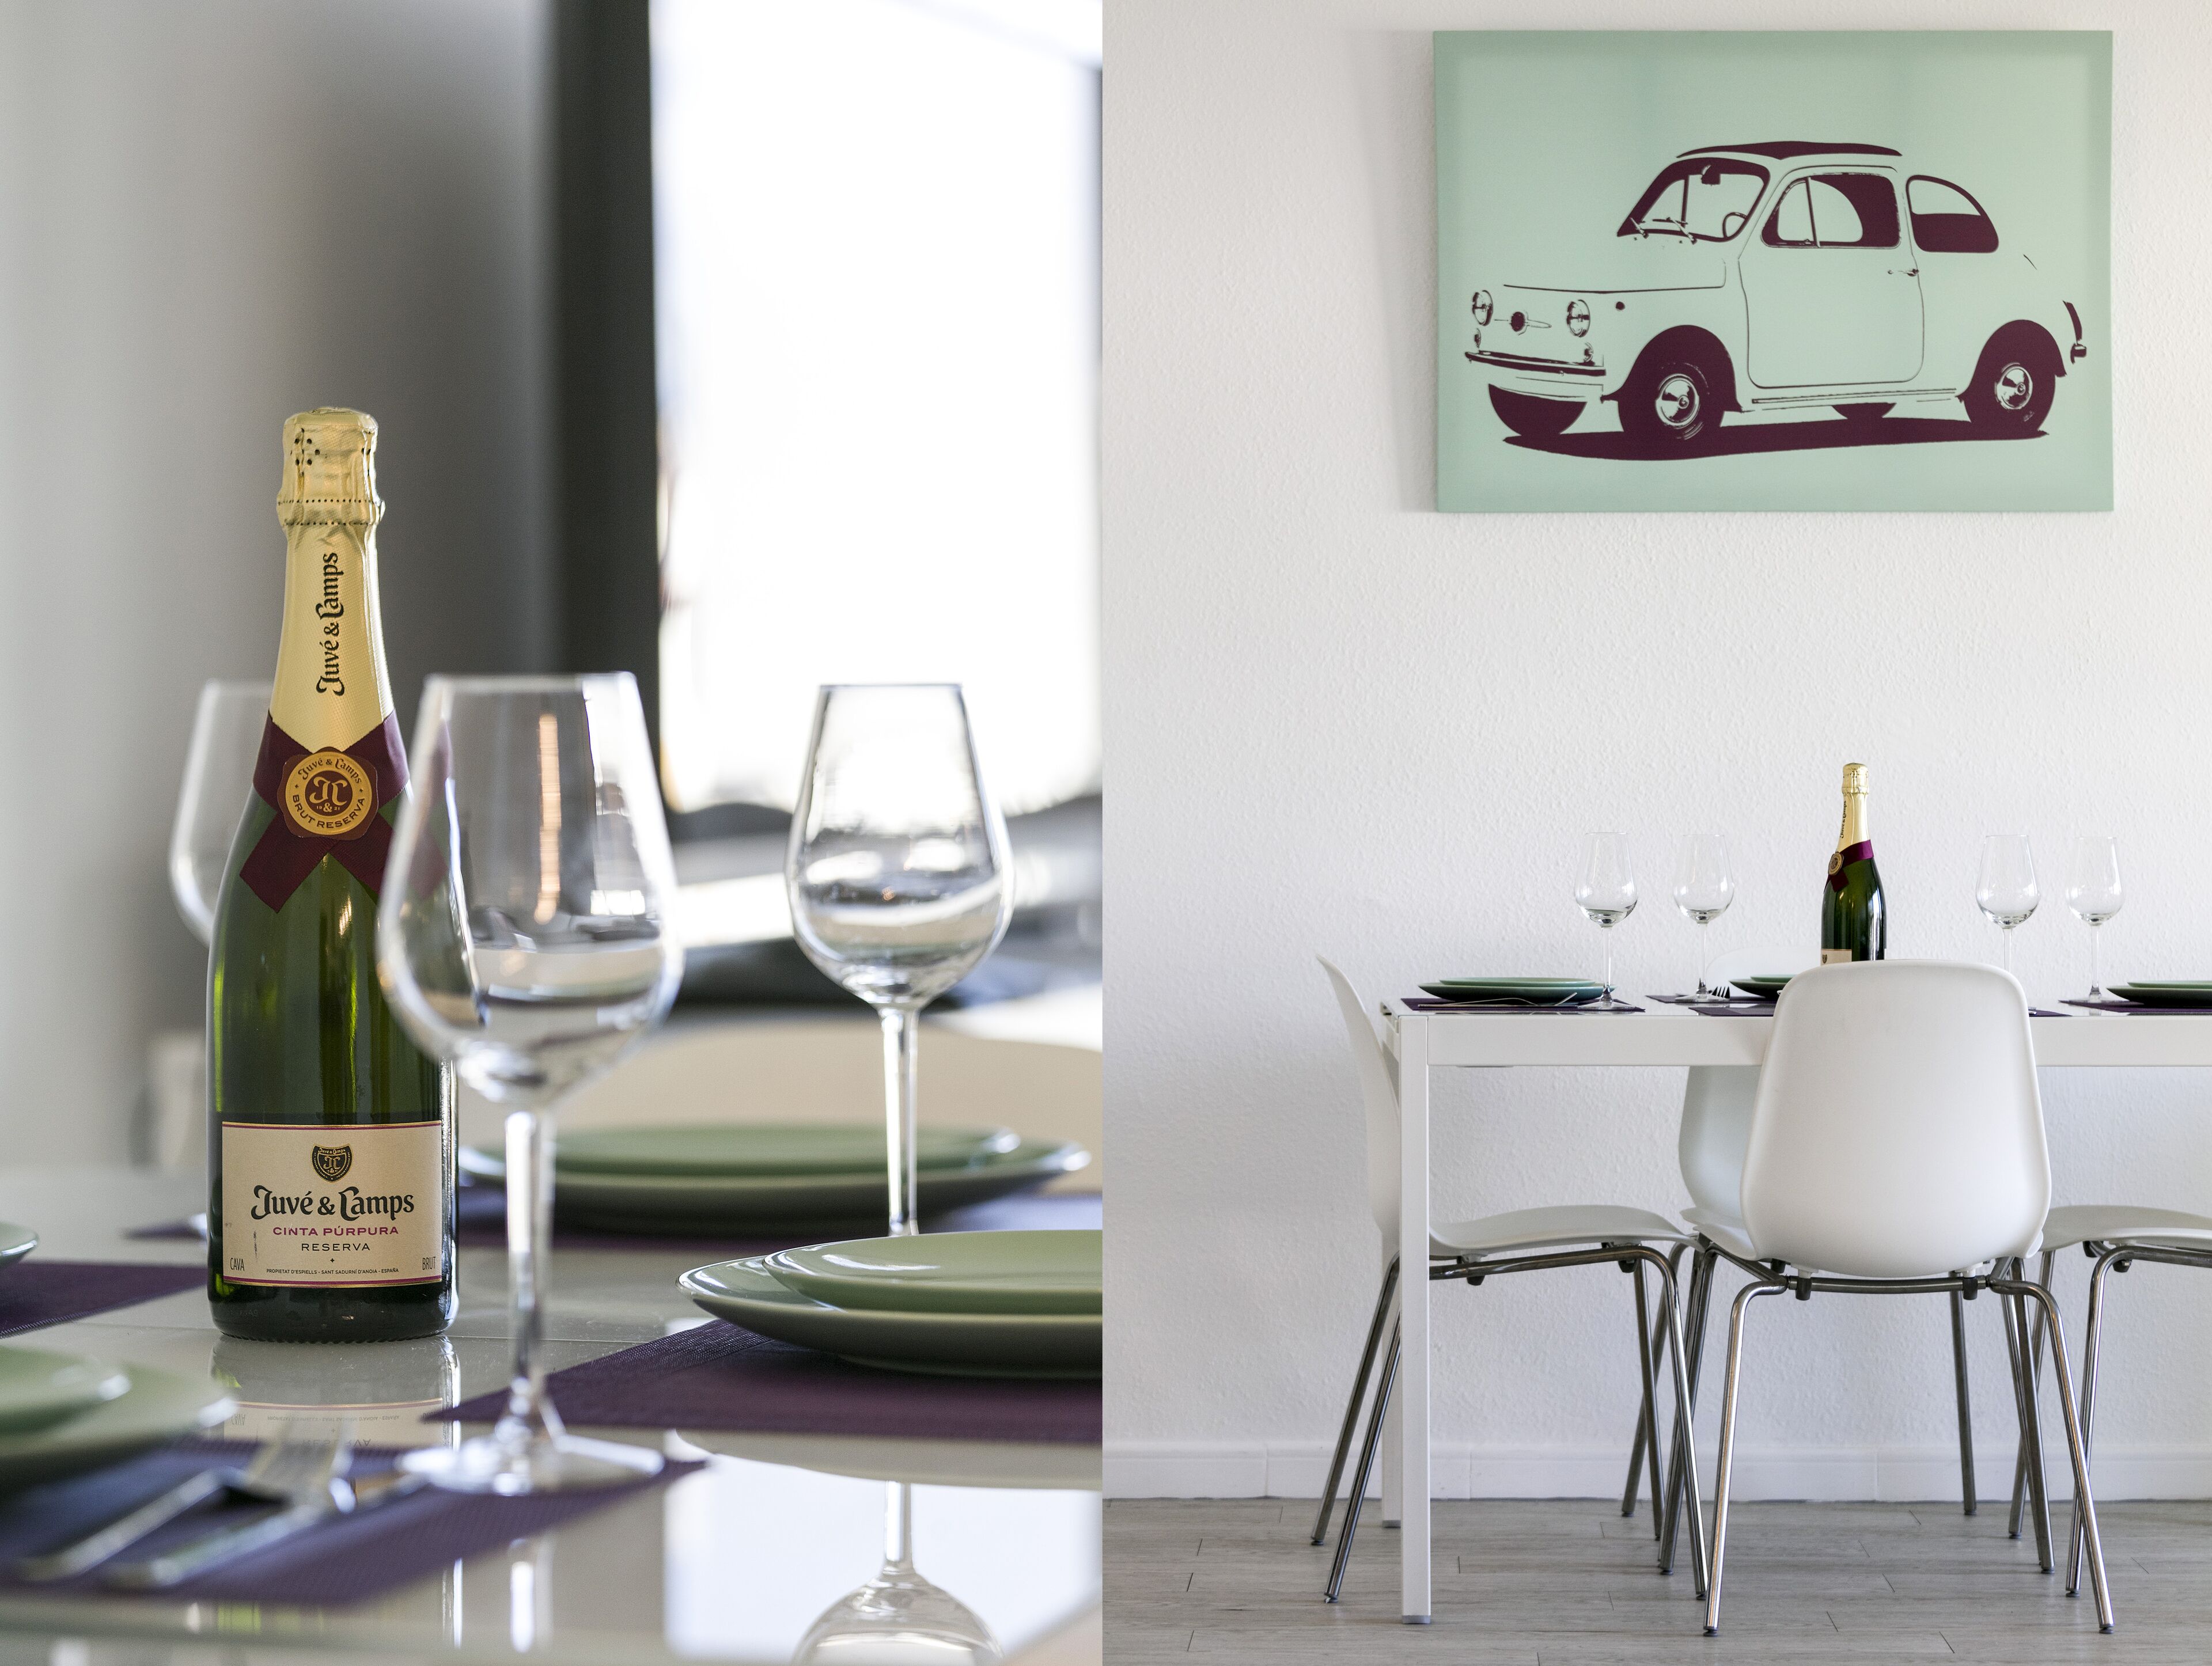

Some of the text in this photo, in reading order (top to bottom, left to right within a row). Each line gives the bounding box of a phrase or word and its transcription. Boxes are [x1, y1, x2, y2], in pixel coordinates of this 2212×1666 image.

[315, 552, 345, 696] Juvé & Camps
[298, 758, 323, 780] Juvé
[335, 758, 362, 784] Camps
[293, 794, 365, 829] BRUT RESERVA
[251, 1185, 414, 1221] Juvé & Camps
[272, 1225, 399, 1236] CINTA PÚRPURA
[301, 1243, 370, 1251] RESERVA
[230, 1257, 245, 1272] CAVA
[422, 1256, 436, 1270] BRUT
